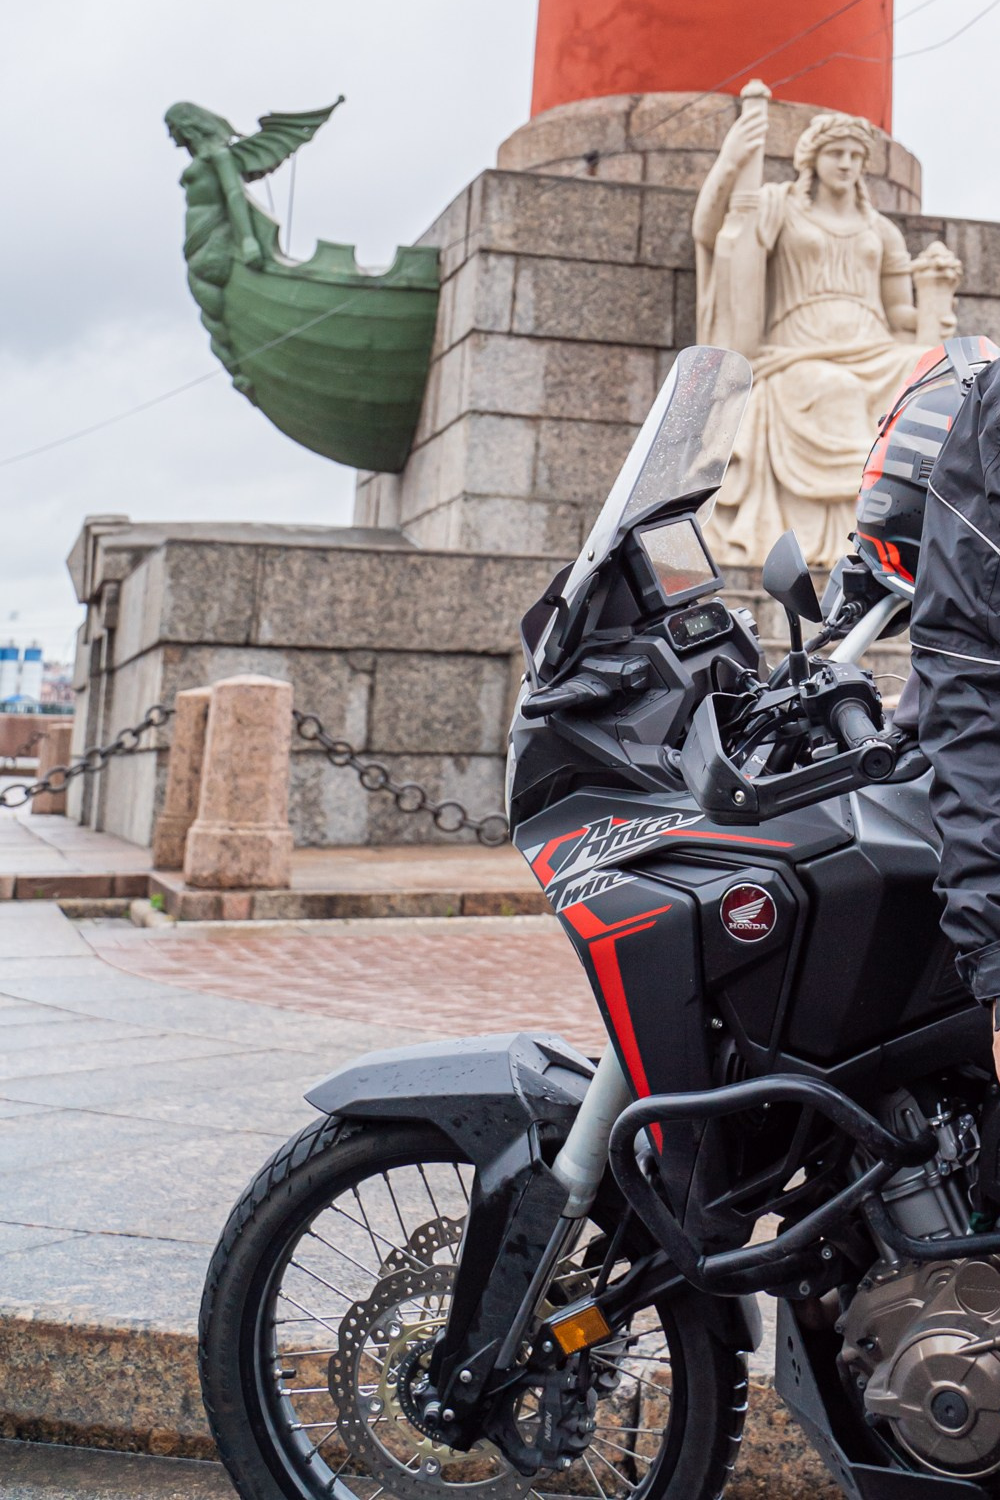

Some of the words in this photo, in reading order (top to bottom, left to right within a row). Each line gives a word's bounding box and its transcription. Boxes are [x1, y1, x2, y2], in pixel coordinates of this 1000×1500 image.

[545, 813, 705, 891] Africa
[546, 869, 639, 913] Twin
[728, 922, 769, 930] HONDA
